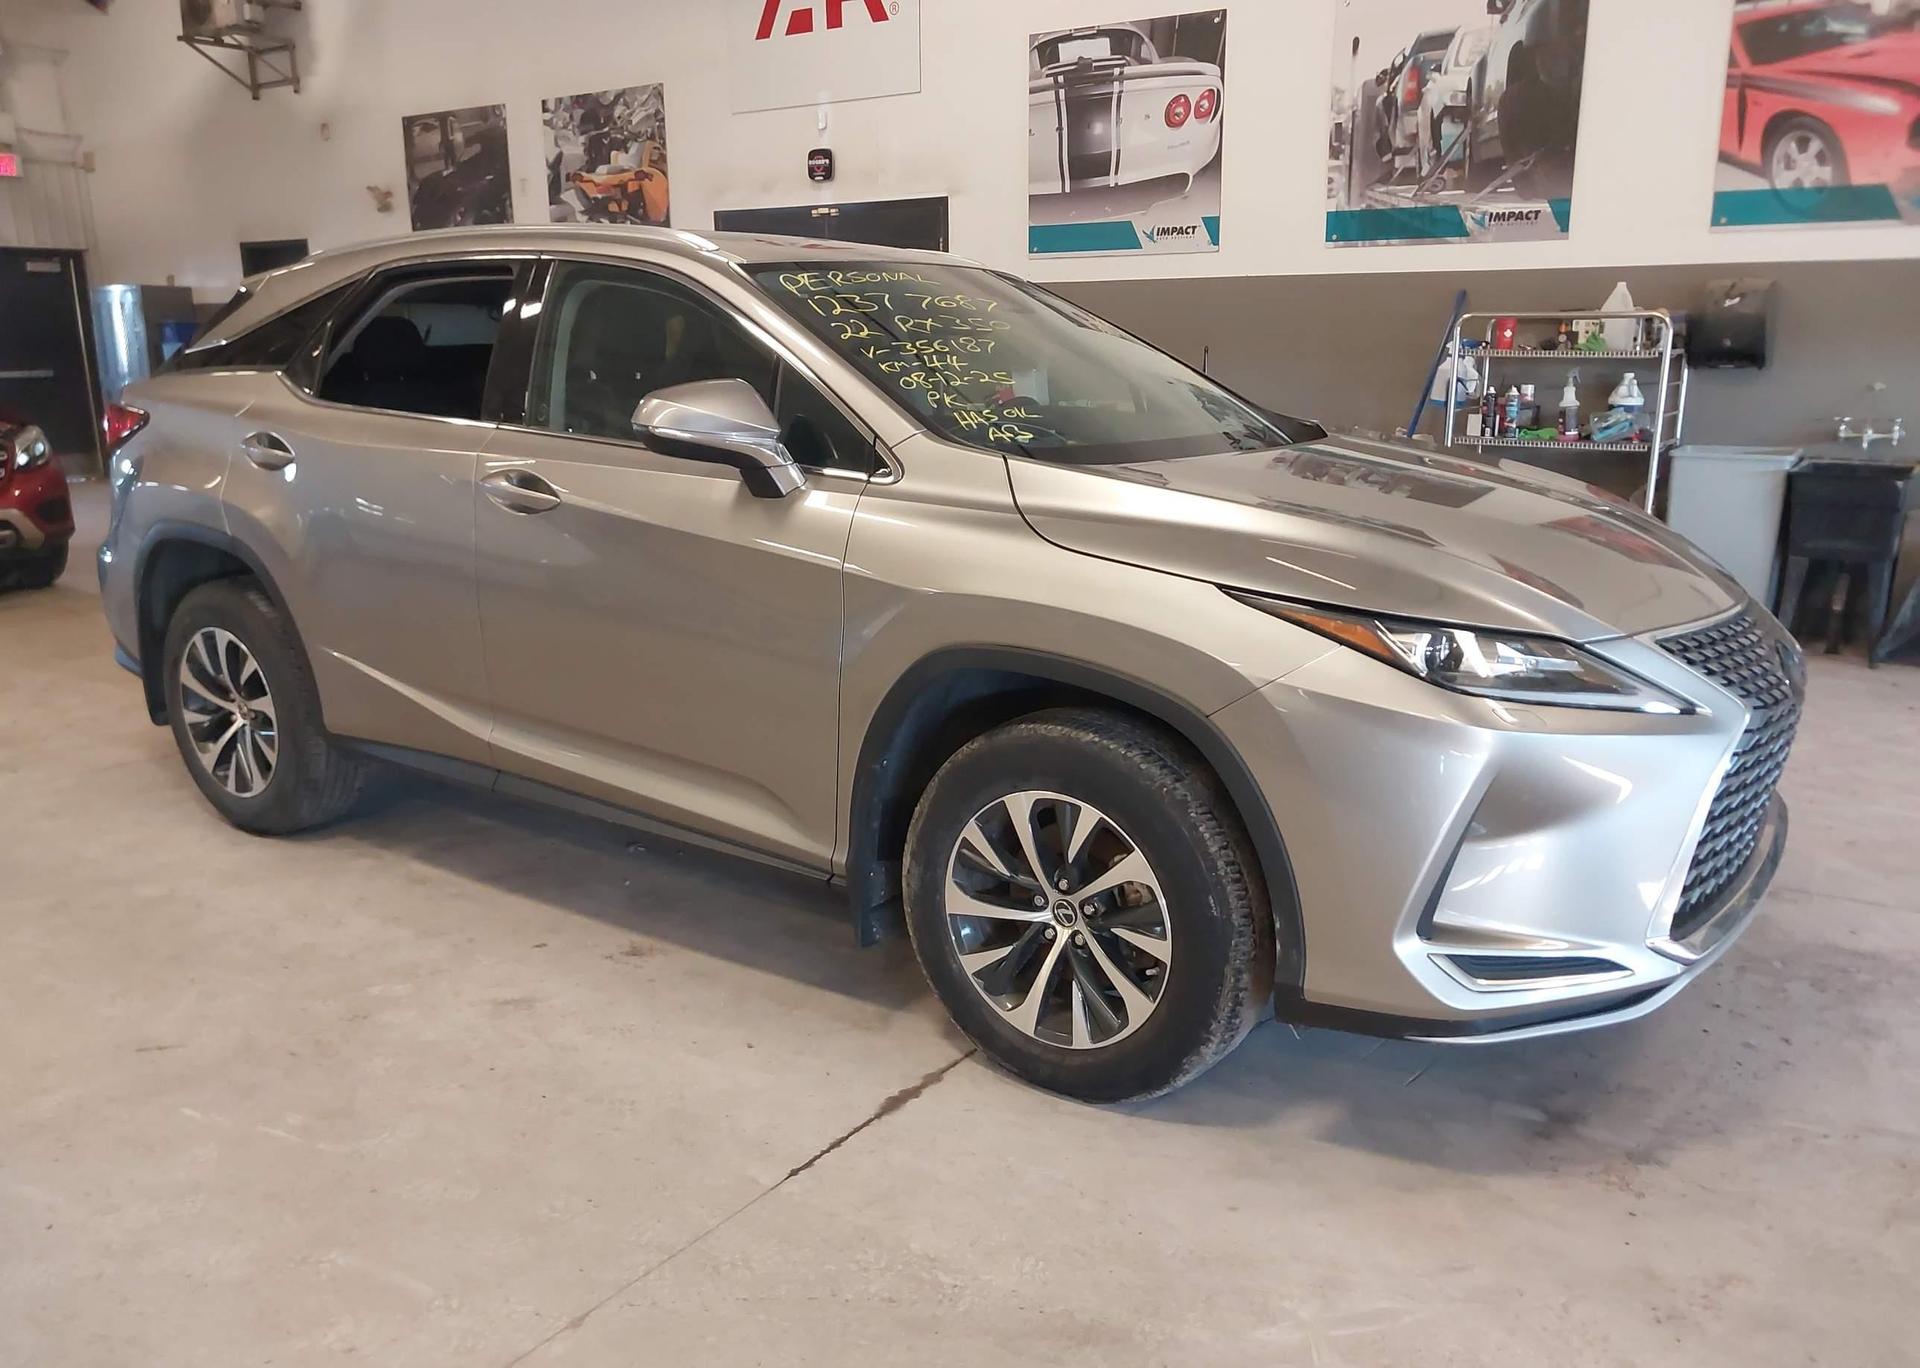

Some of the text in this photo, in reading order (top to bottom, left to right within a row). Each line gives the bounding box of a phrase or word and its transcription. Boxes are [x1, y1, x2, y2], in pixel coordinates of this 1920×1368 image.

[1488, 209, 1542, 223] IMPACT
[1156, 225, 1198, 237] IMPACT
[779, 270, 941, 297] PERSONAL
[807, 292, 894, 317] 1237
[830, 319, 885, 340] 22
[953, 409, 999, 431] HAS
